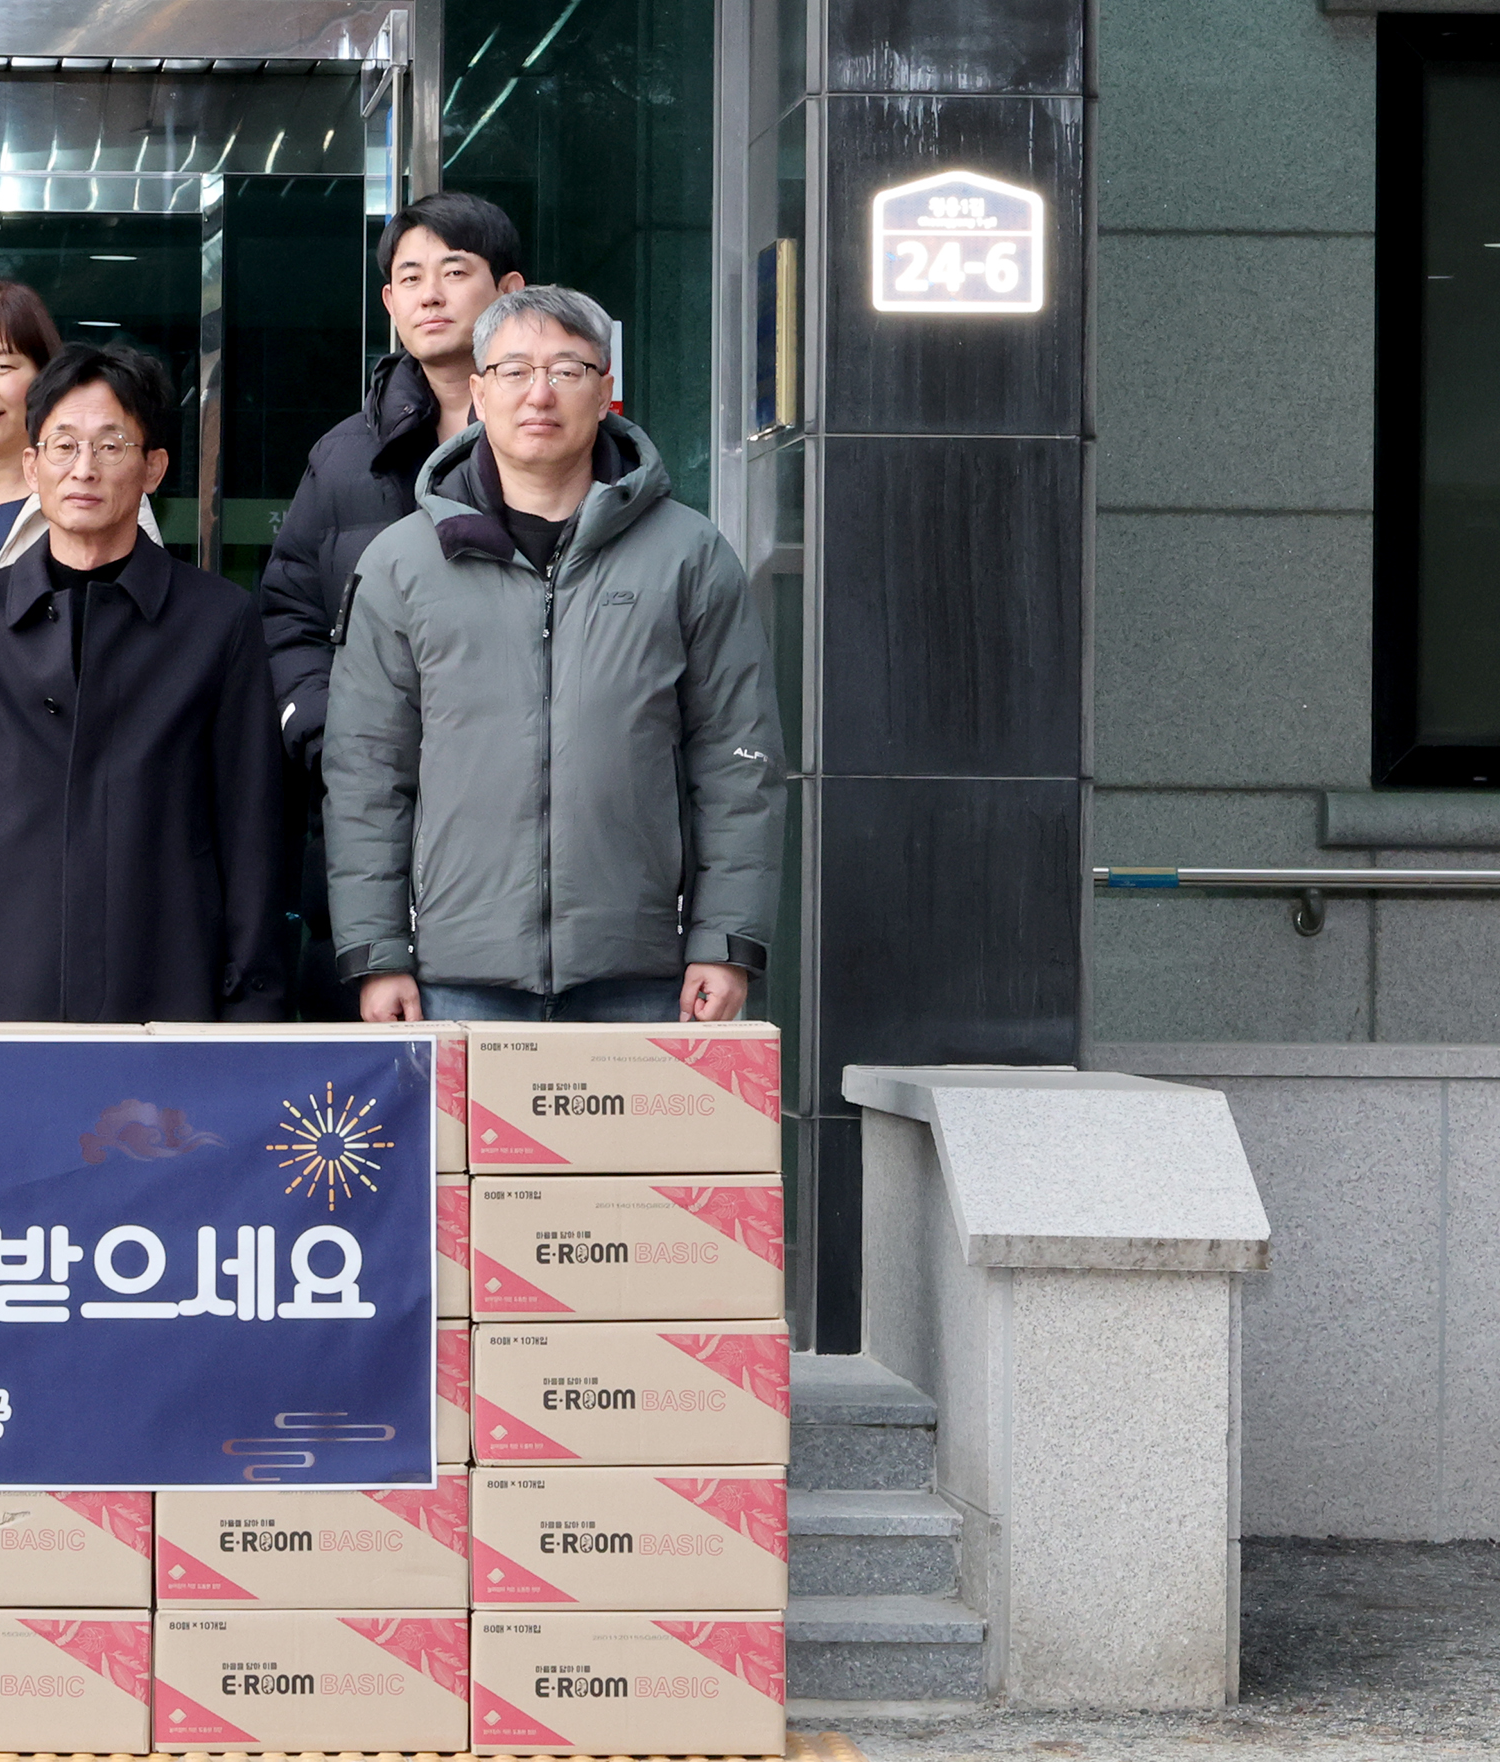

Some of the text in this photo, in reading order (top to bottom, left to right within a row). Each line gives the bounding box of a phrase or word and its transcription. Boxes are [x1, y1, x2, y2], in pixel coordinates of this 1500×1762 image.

[895, 240, 1019, 293] 24-6
[631, 1094, 714, 1116] BASIC
[635, 1242, 718, 1264] BASIC
[642, 1388, 725, 1410] BASIC
[1, 1527, 84, 1549] BASIC
[319, 1530, 402, 1552] BASIC
[640, 1531, 723, 1553] BASIC
[0, 1673, 83, 1695] BASIC
[321, 1673, 404, 1695] BASIC
[634, 1676, 717, 1698] BASIC
